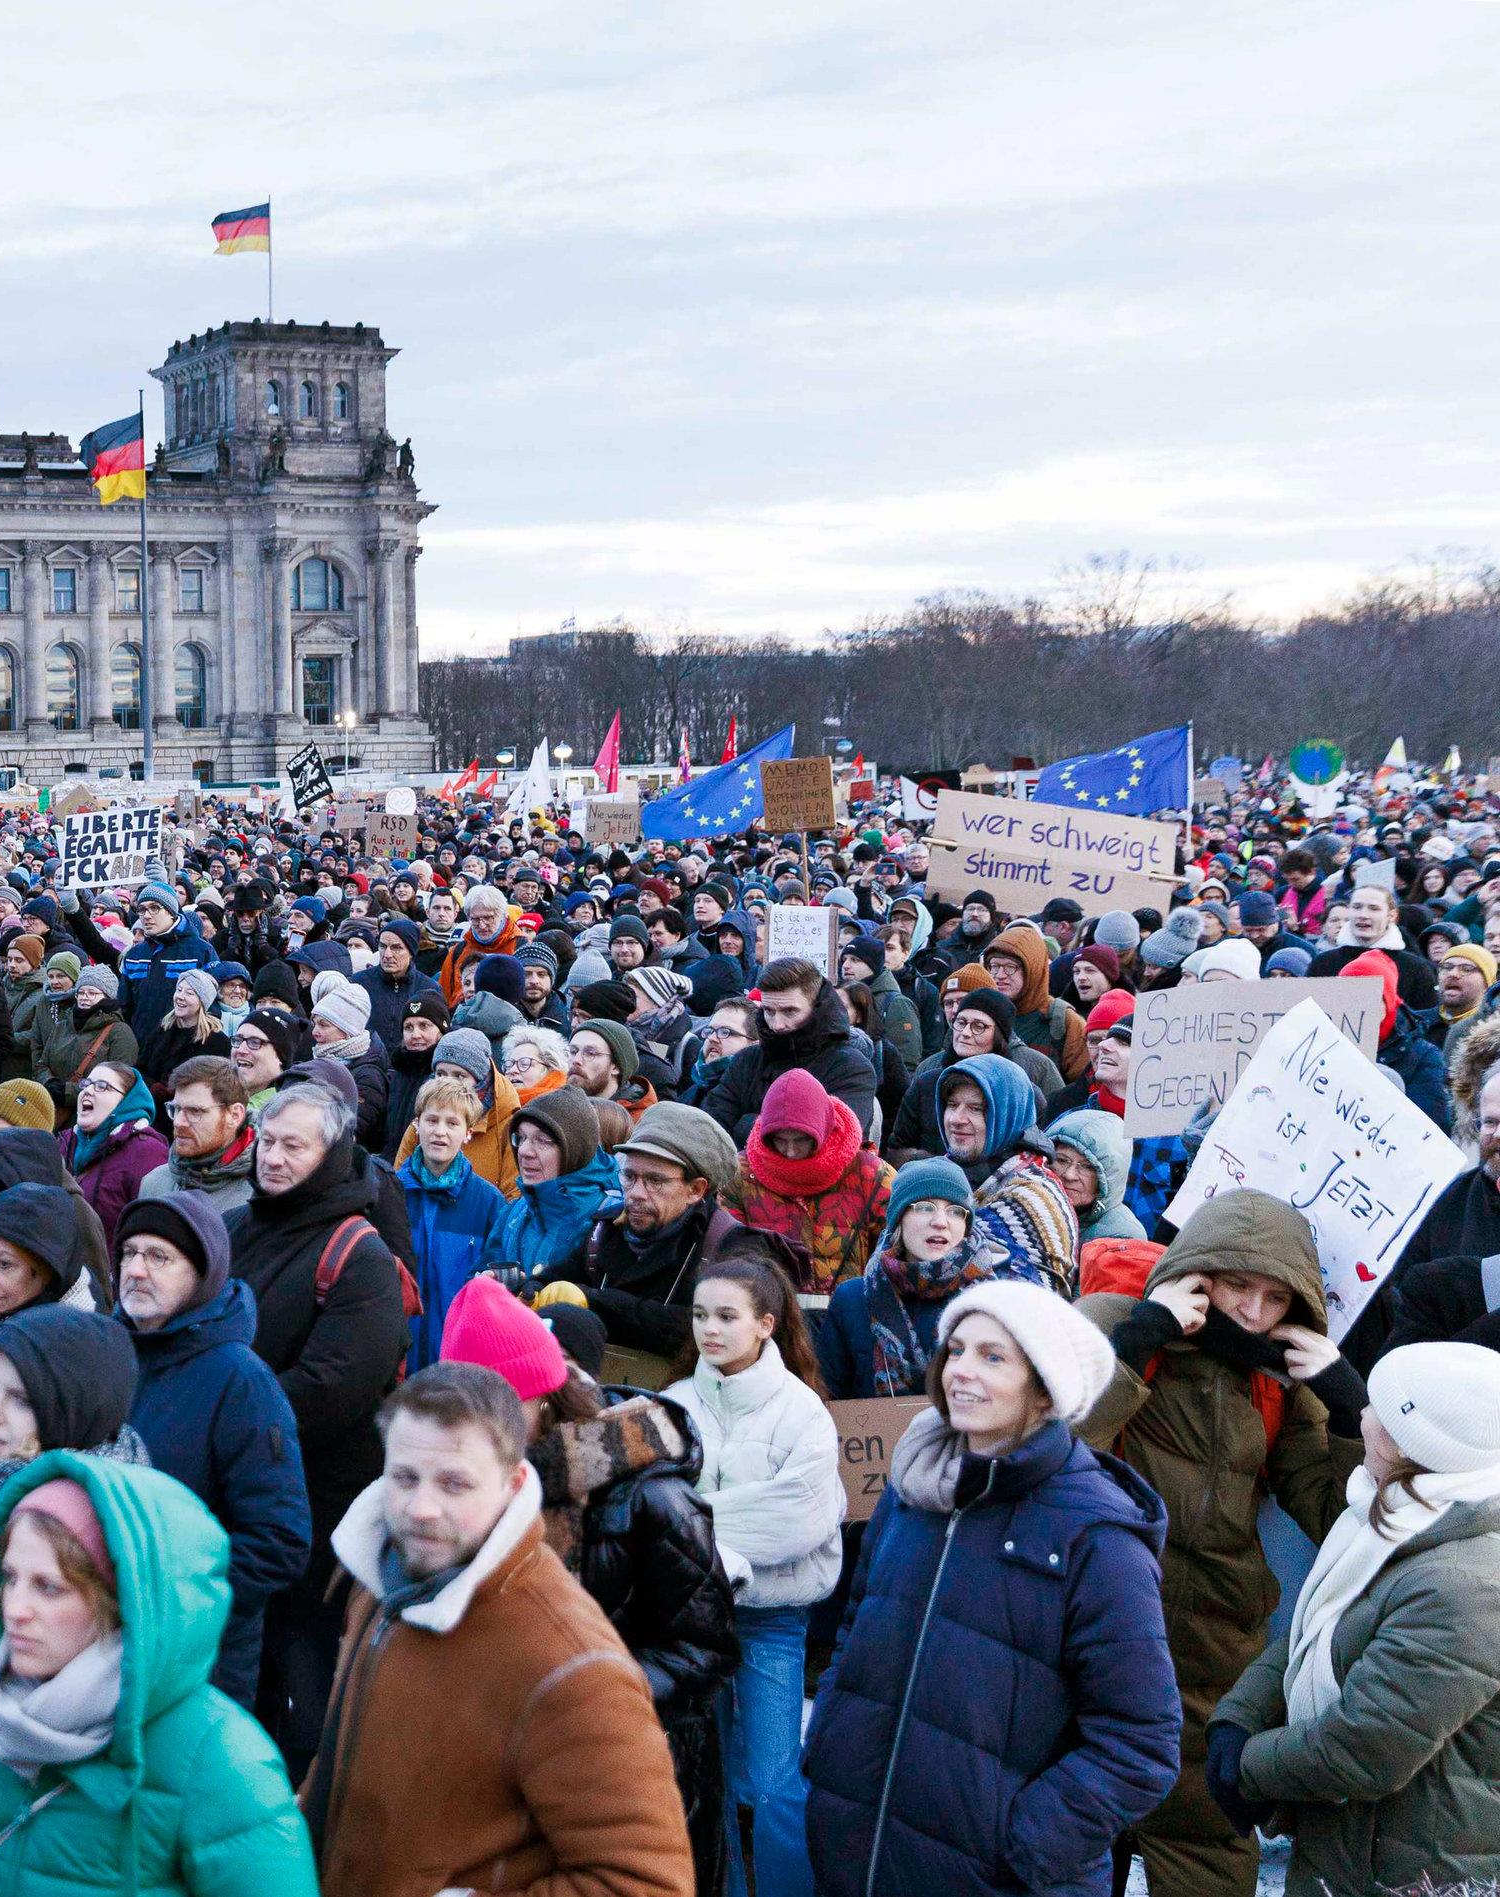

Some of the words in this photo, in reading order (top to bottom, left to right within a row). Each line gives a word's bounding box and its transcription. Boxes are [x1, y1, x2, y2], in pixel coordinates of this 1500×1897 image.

[765, 762, 825, 777] MEMO:
[588, 804, 604, 819] Nie
[65, 827, 159, 859] ÉGALITÉ
[961, 810, 1023, 838] wer
[1029, 816, 1163, 872] schweigt
[1068, 871, 1116, 895] zu
[1142, 993, 1366, 1048] SCHWESTN
[1133, 1055, 1227, 1109] GEGEN
[1276, 1112, 1307, 1145] ist
[838, 1434, 885, 1464] en
